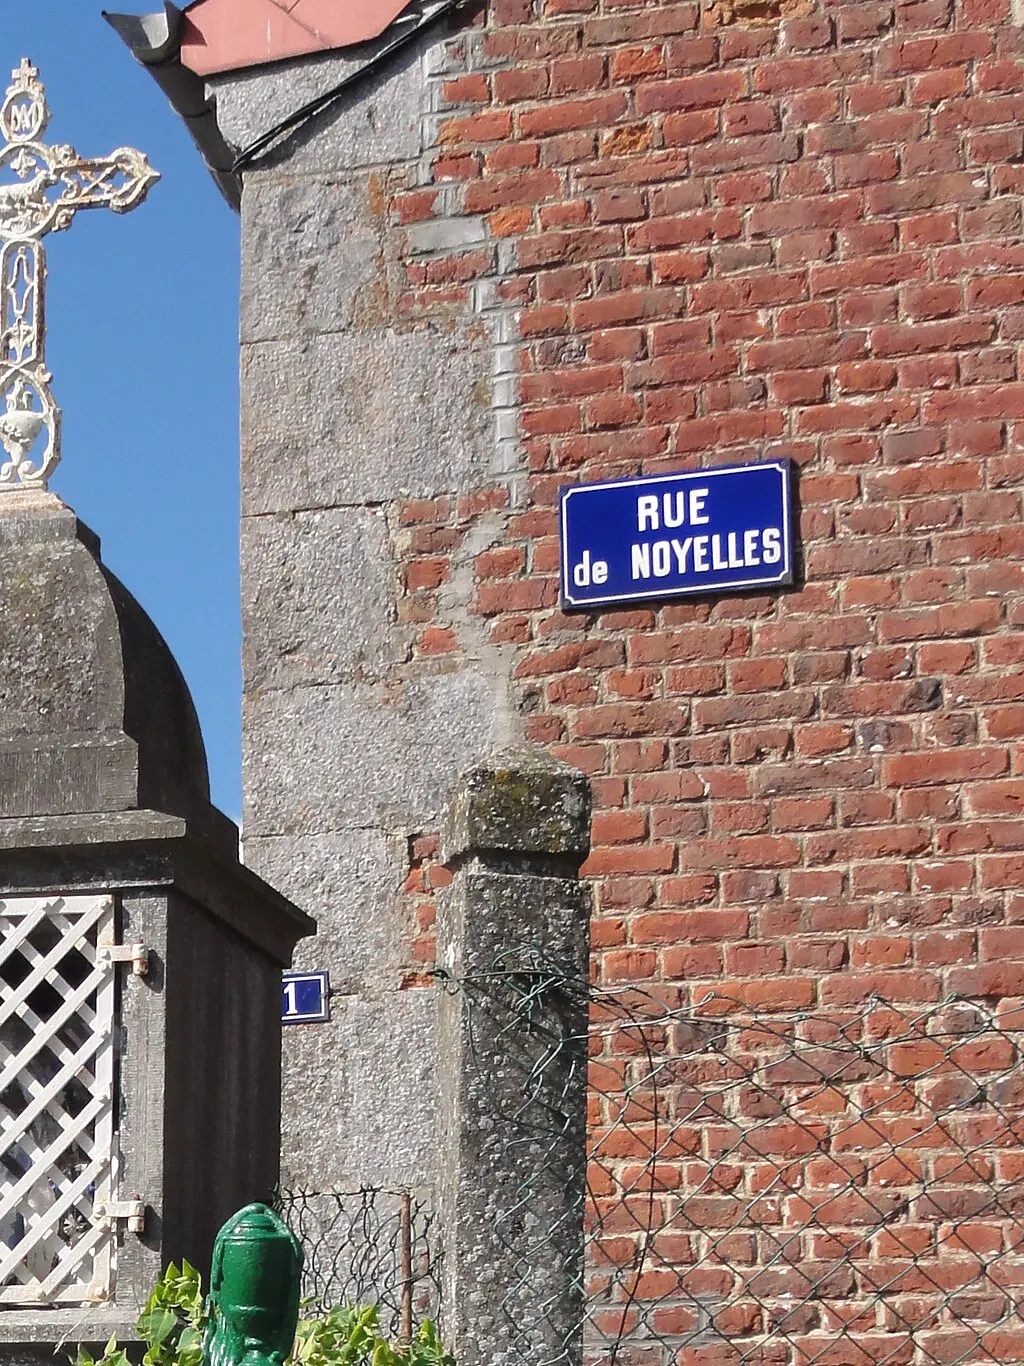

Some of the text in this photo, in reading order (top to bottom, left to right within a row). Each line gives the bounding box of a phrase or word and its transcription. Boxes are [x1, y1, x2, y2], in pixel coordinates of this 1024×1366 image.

[637, 488, 710, 532] RUE
[573, 527, 781, 587] de NOYELLES
[283, 982, 298, 1014] 1
